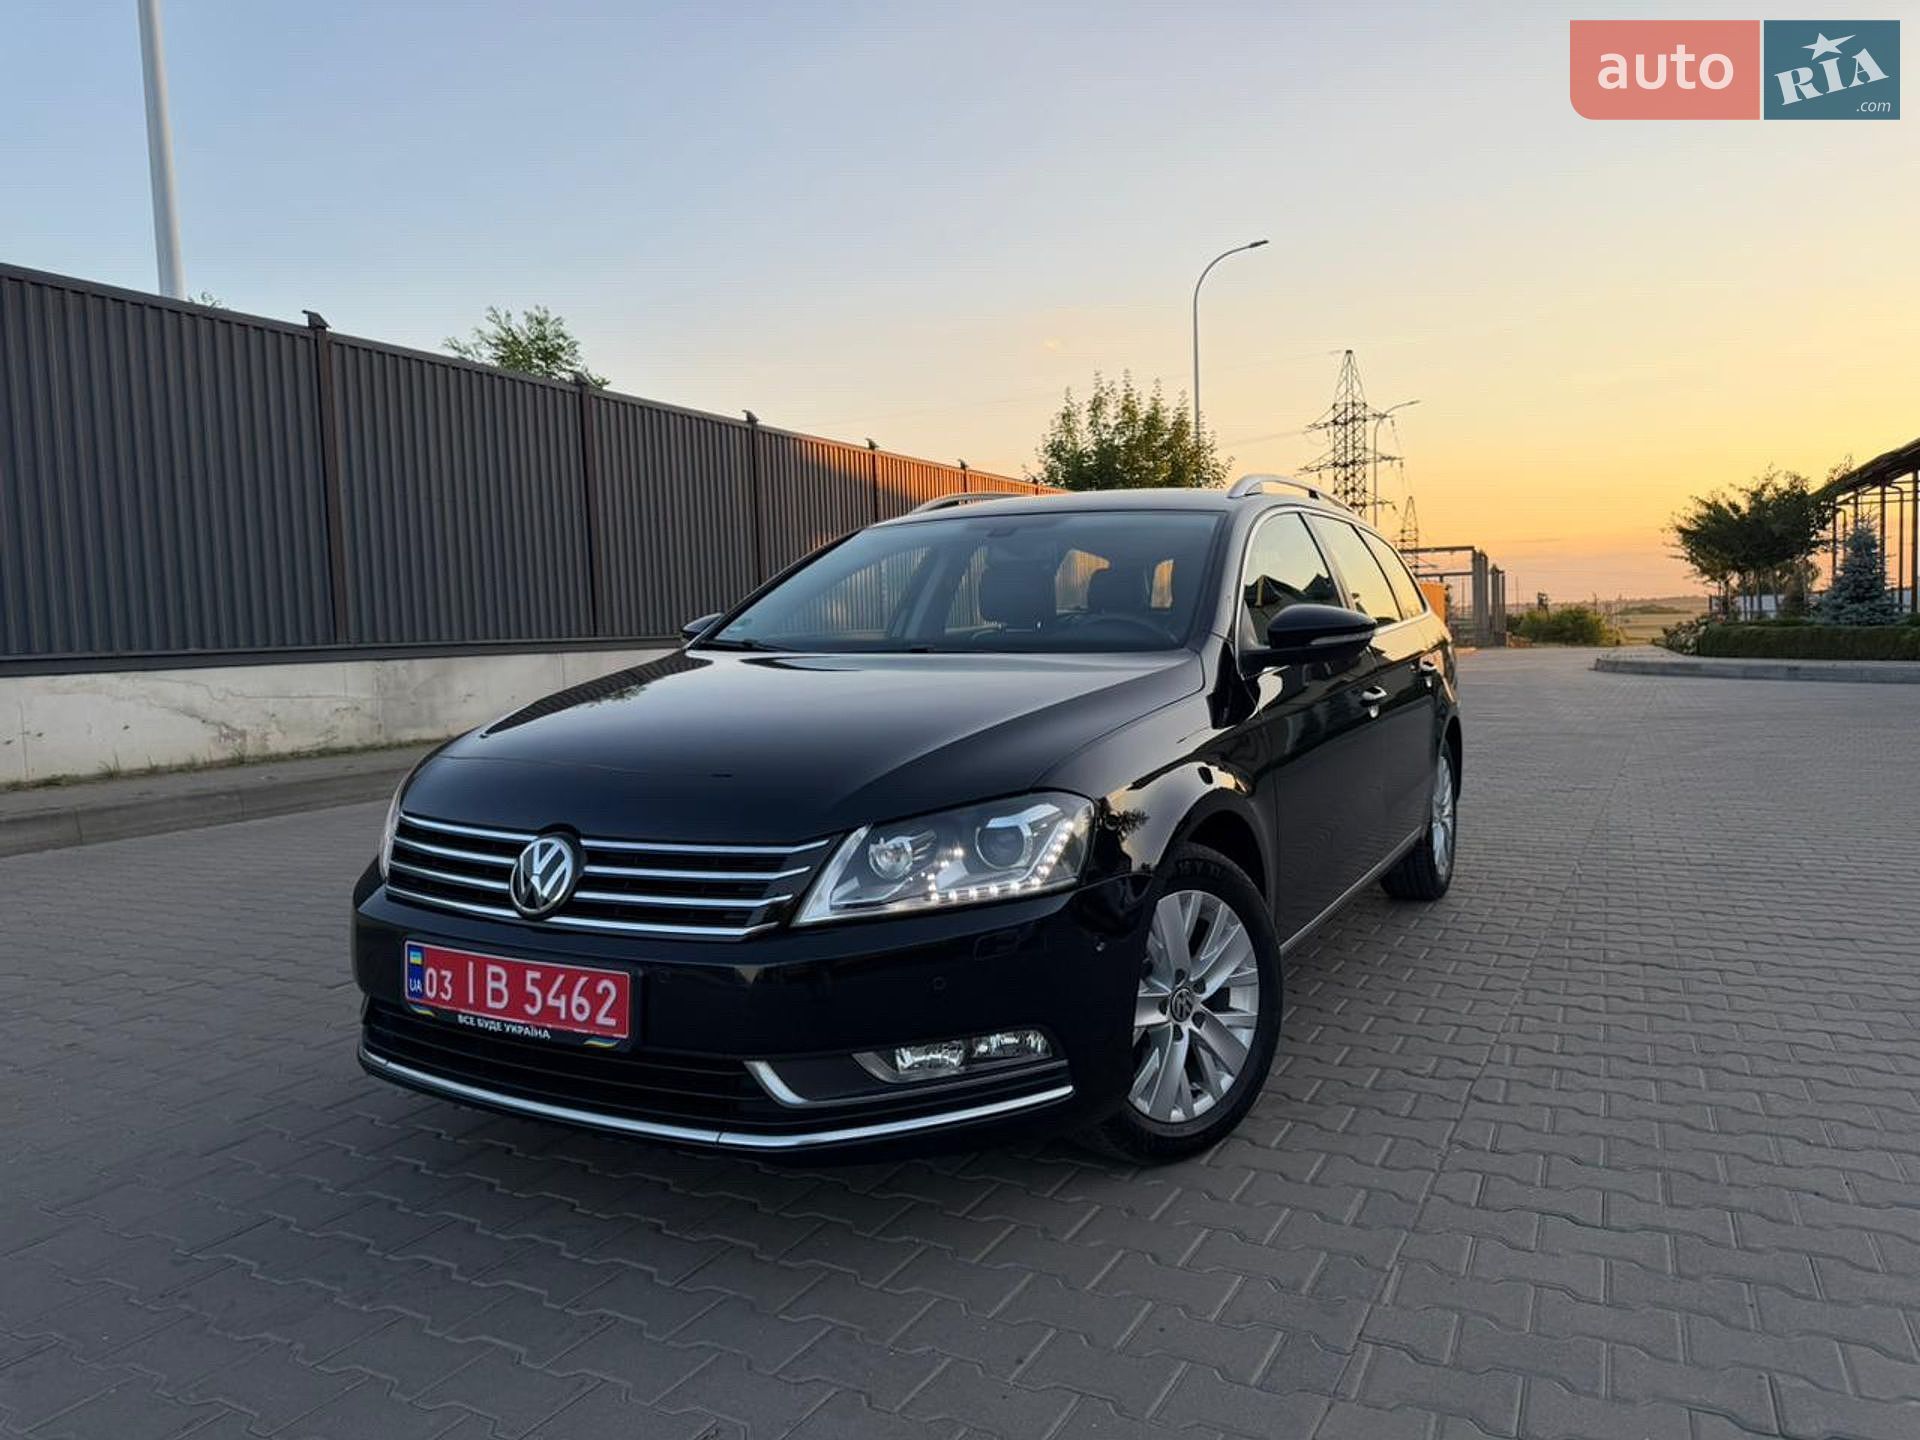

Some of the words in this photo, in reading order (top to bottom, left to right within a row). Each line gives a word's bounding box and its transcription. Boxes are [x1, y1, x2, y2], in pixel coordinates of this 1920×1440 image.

[409, 980, 423, 993] UA
[425, 967, 453, 1001] 03
[524, 970, 617, 1027] 5462
[457, 1014, 476, 1028] ВСЕ
[476, 1017, 503, 1033] БУДЕ
[503, 1022, 551, 1040] УКРАЇНА
